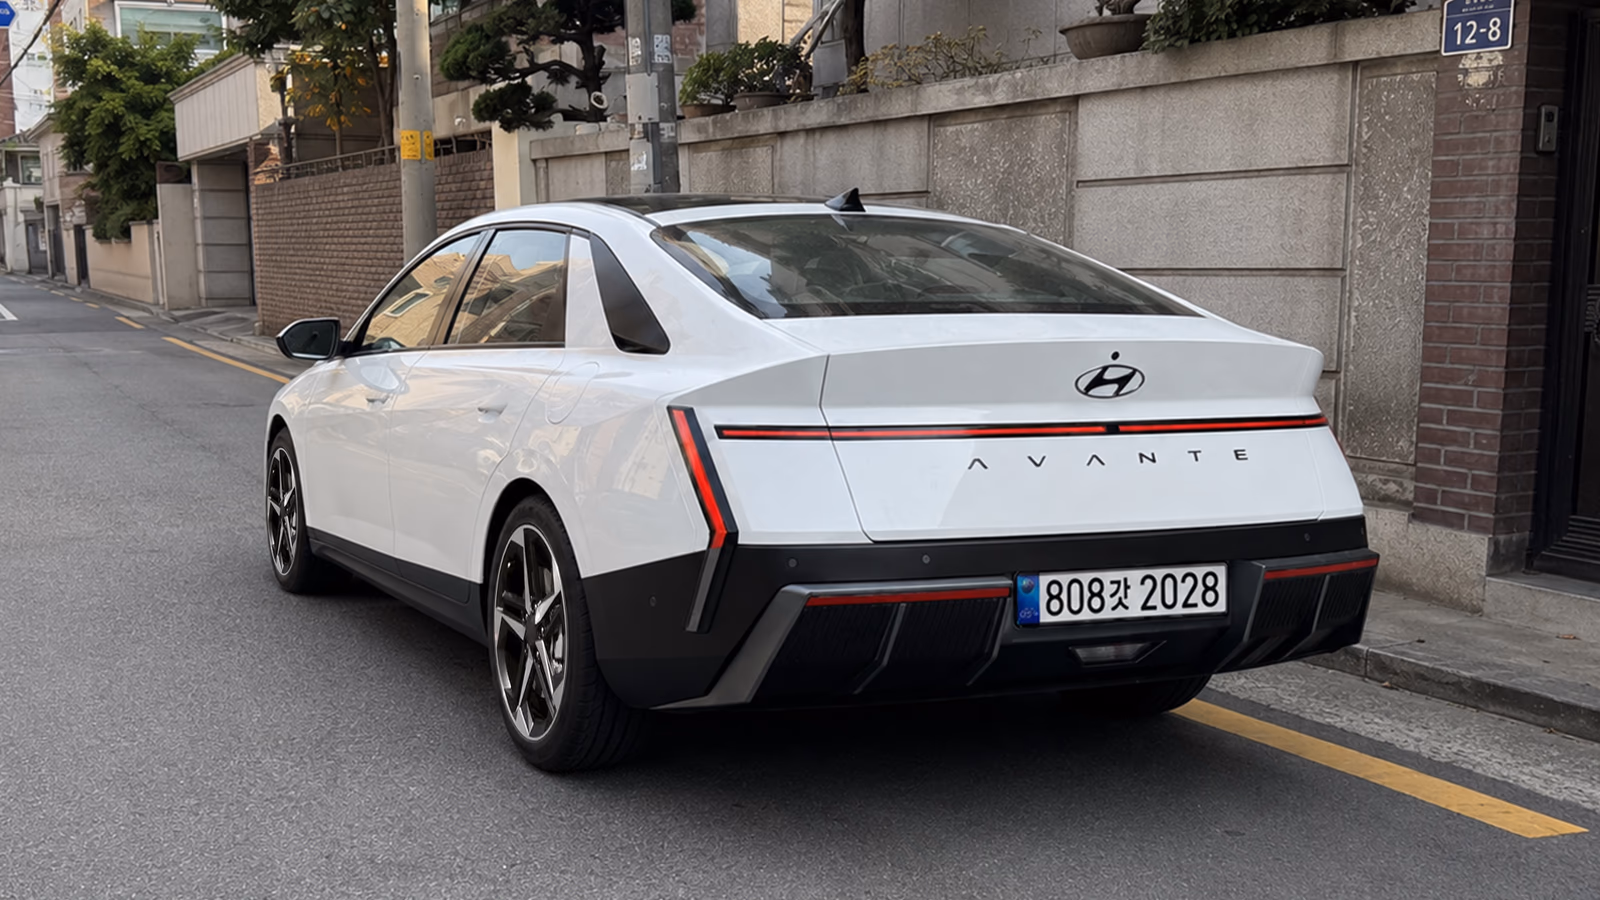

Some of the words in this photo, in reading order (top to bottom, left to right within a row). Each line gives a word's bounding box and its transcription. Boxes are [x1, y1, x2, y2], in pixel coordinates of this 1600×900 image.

[1453, 16, 1501, 46] 12-8
[967, 448, 1249, 471] AVANTE
[1045, 577, 1131, 616] 808갓
[1140, 571, 1219, 611] 2028
